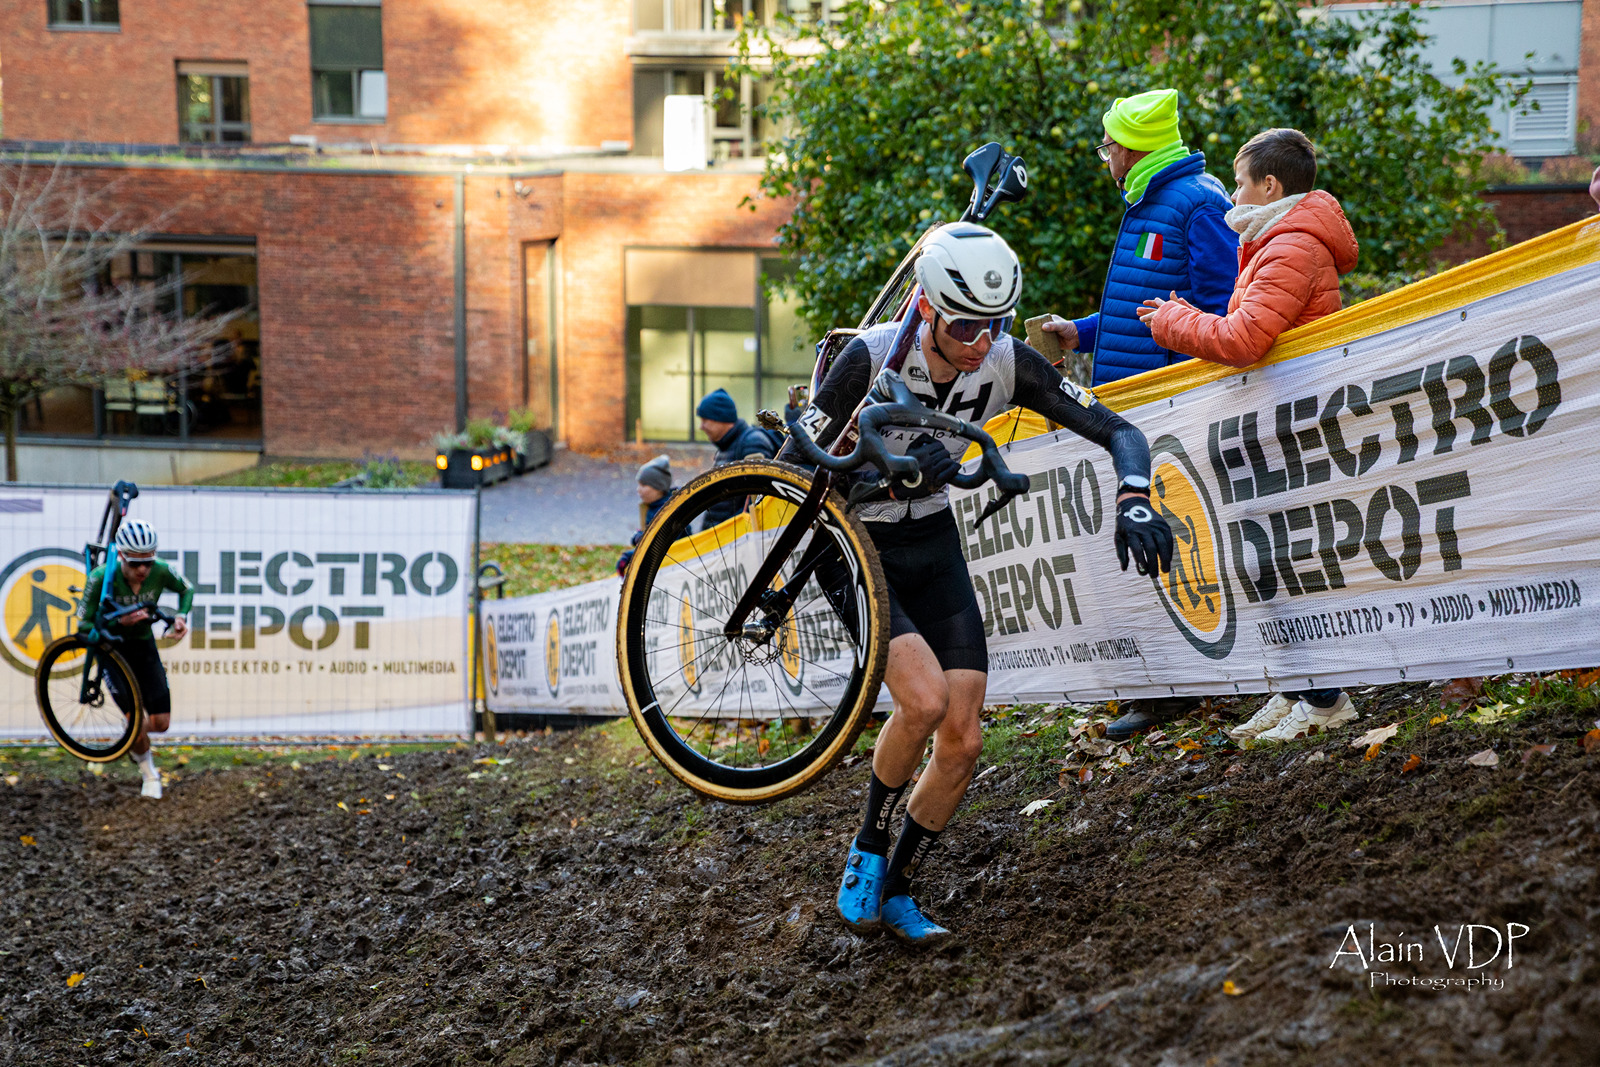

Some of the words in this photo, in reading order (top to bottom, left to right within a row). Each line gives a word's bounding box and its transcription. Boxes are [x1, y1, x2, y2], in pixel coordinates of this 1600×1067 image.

[1062, 382, 1081, 400] 2
[800, 405, 828, 435] 24
[1208, 334, 1562, 505] ELECTRO
[955, 459, 1103, 563] ELECTRO
[1227, 470, 1471, 603] DEPOT
[497, 611, 535, 643] ELECTRO
[563, 596, 610, 637] ELECTRO
[1258, 606, 1382, 645] HUISHOUDELEKTRO
[1396, 602, 1414, 628] TV
[1431, 593, 1473, 625] AUDIO
[1488, 579, 1582, 617] MULTIMEDIA
[162, 661, 279, 674] SHOUDELEKTRO
[299, 661, 312, 673] TV
[330, 661, 367, 674] AUDIO
[383, 661, 456, 674] MULTIMEDIA
[498, 649, 526, 679] DEPOT
[562, 640, 596, 678] DEPOT
[697, 625, 745, 673] DEPO
[1054, 645, 1066, 665] TV
[1069, 642, 1092, 663] AUDIO
[1095, 637, 1142, 661] MULTIMEDIA
